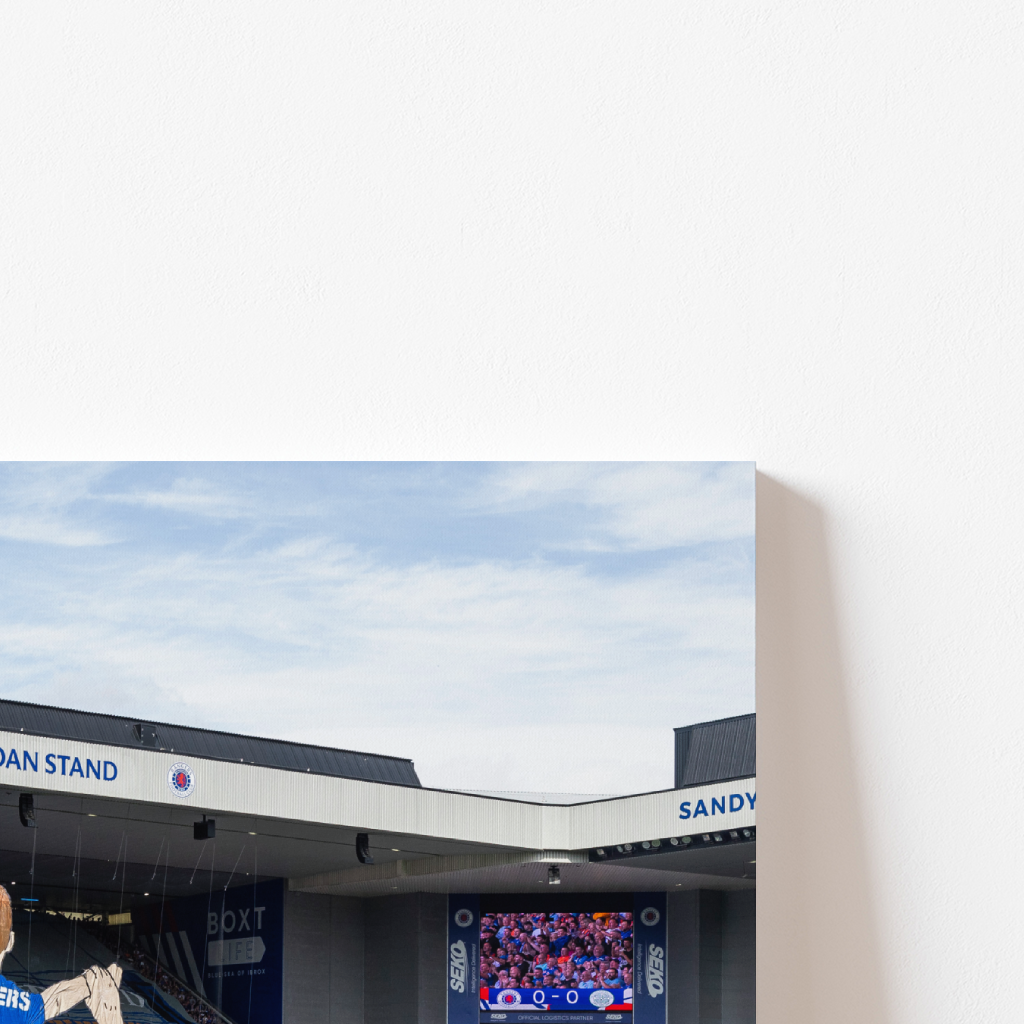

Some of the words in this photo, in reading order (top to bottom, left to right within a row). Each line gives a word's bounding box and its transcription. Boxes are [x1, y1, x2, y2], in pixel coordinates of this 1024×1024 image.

[45, 753, 118, 782] STAND
[679, 790, 756, 820] SANDY
[206, 906, 266, 935] BOXT
[247, 968, 266, 976] IBROX
[450, 940, 468, 993] SEKO
[647, 943, 664, 998] SEKO
[533, 990, 545, 1004] 0
[566, 990, 579, 1004] 0
